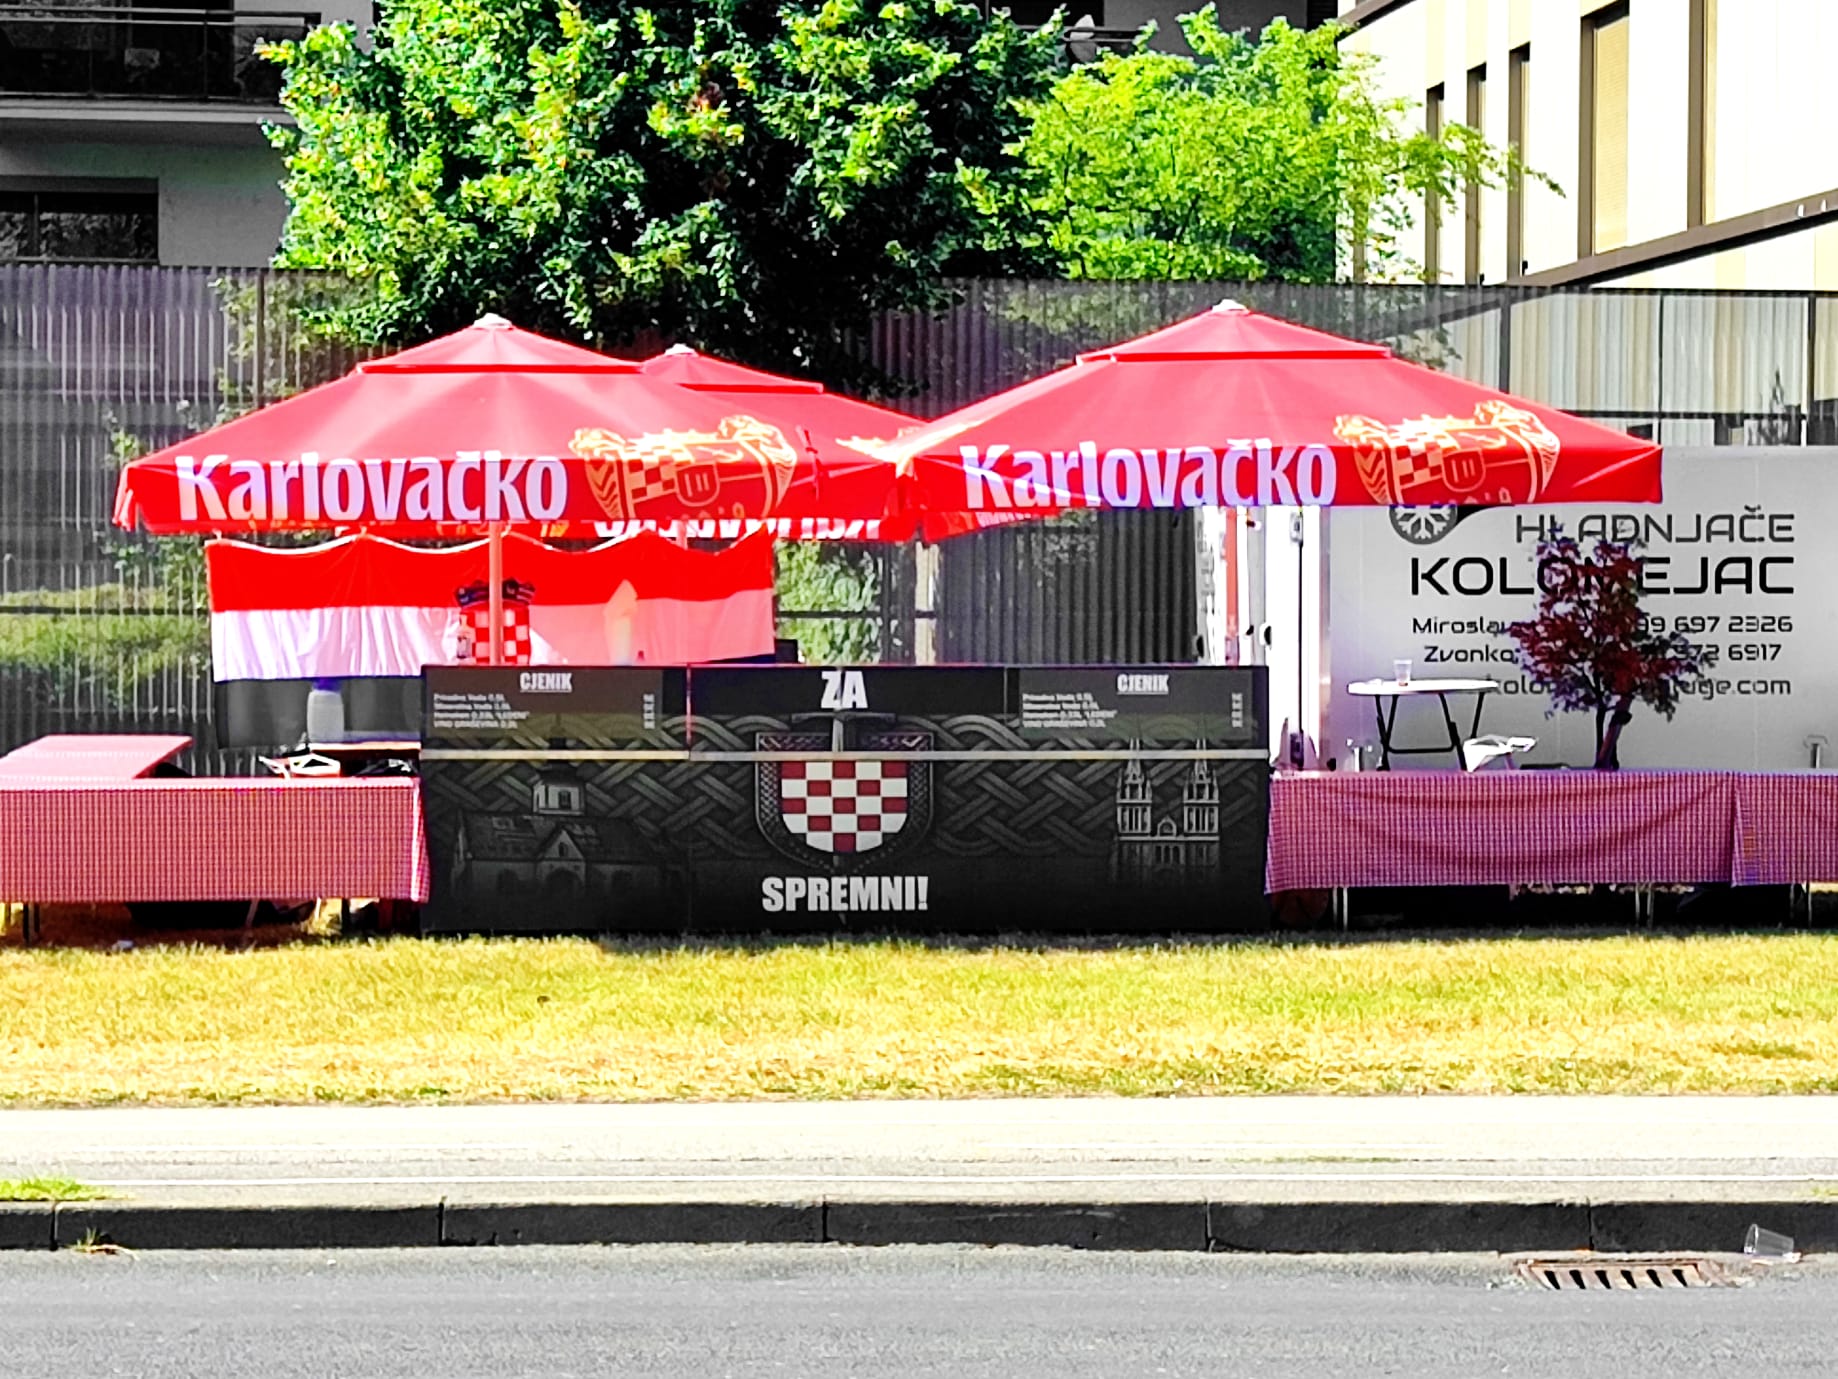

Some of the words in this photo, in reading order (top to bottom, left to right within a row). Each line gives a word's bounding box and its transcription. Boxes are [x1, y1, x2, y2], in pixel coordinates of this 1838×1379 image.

[175, 450, 567, 520] Karlovačko
[960, 439, 1338, 508] Karlovačko
[1516, 504, 1794, 543] HLADNJAČE
[1674, 616, 1720, 633] 697
[1728, 616, 1793, 633] 2326
[1728, 644, 1782, 661] 6917
[520, 673, 571, 690] CJENIK
[820, 671, 868, 709] ZA
[1117, 674, 1169, 691] CJENIK
[762, 876, 929, 912] SPREMNI!
